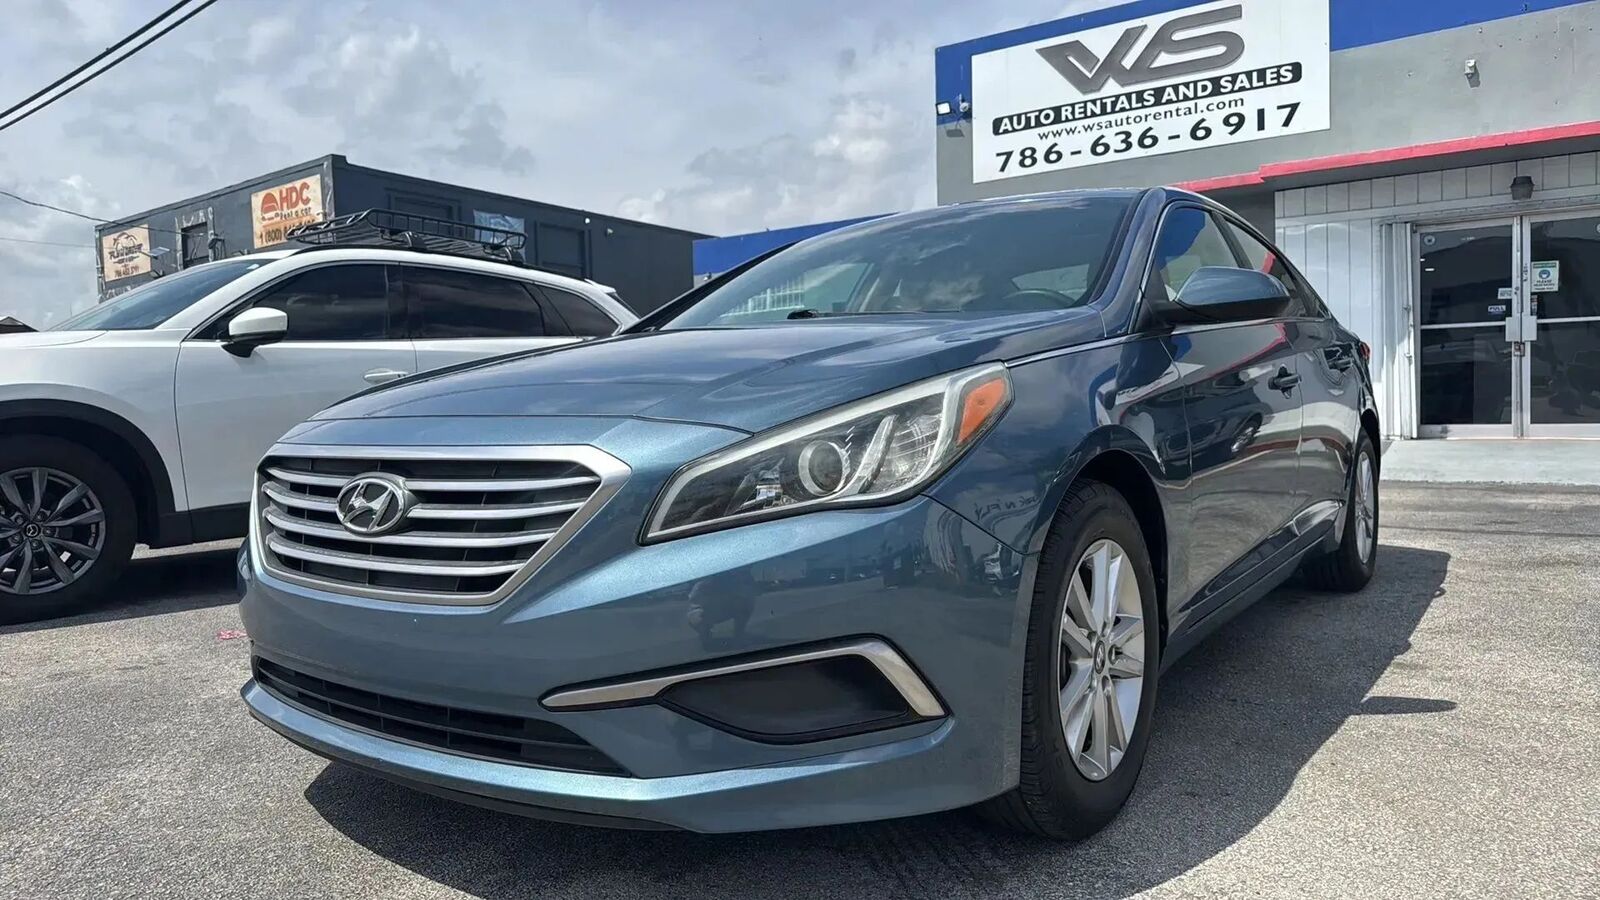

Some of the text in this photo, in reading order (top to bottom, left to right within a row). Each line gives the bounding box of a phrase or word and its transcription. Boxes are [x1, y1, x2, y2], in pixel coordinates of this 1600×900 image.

[998, 65, 1293, 133] AUTO RENTALS AND SALES
[1037, 97, 1245, 140] www.wsautorental.com
[995, 101, 1301, 173] 786-636-6917
[279, 182, 311, 211] HDC
